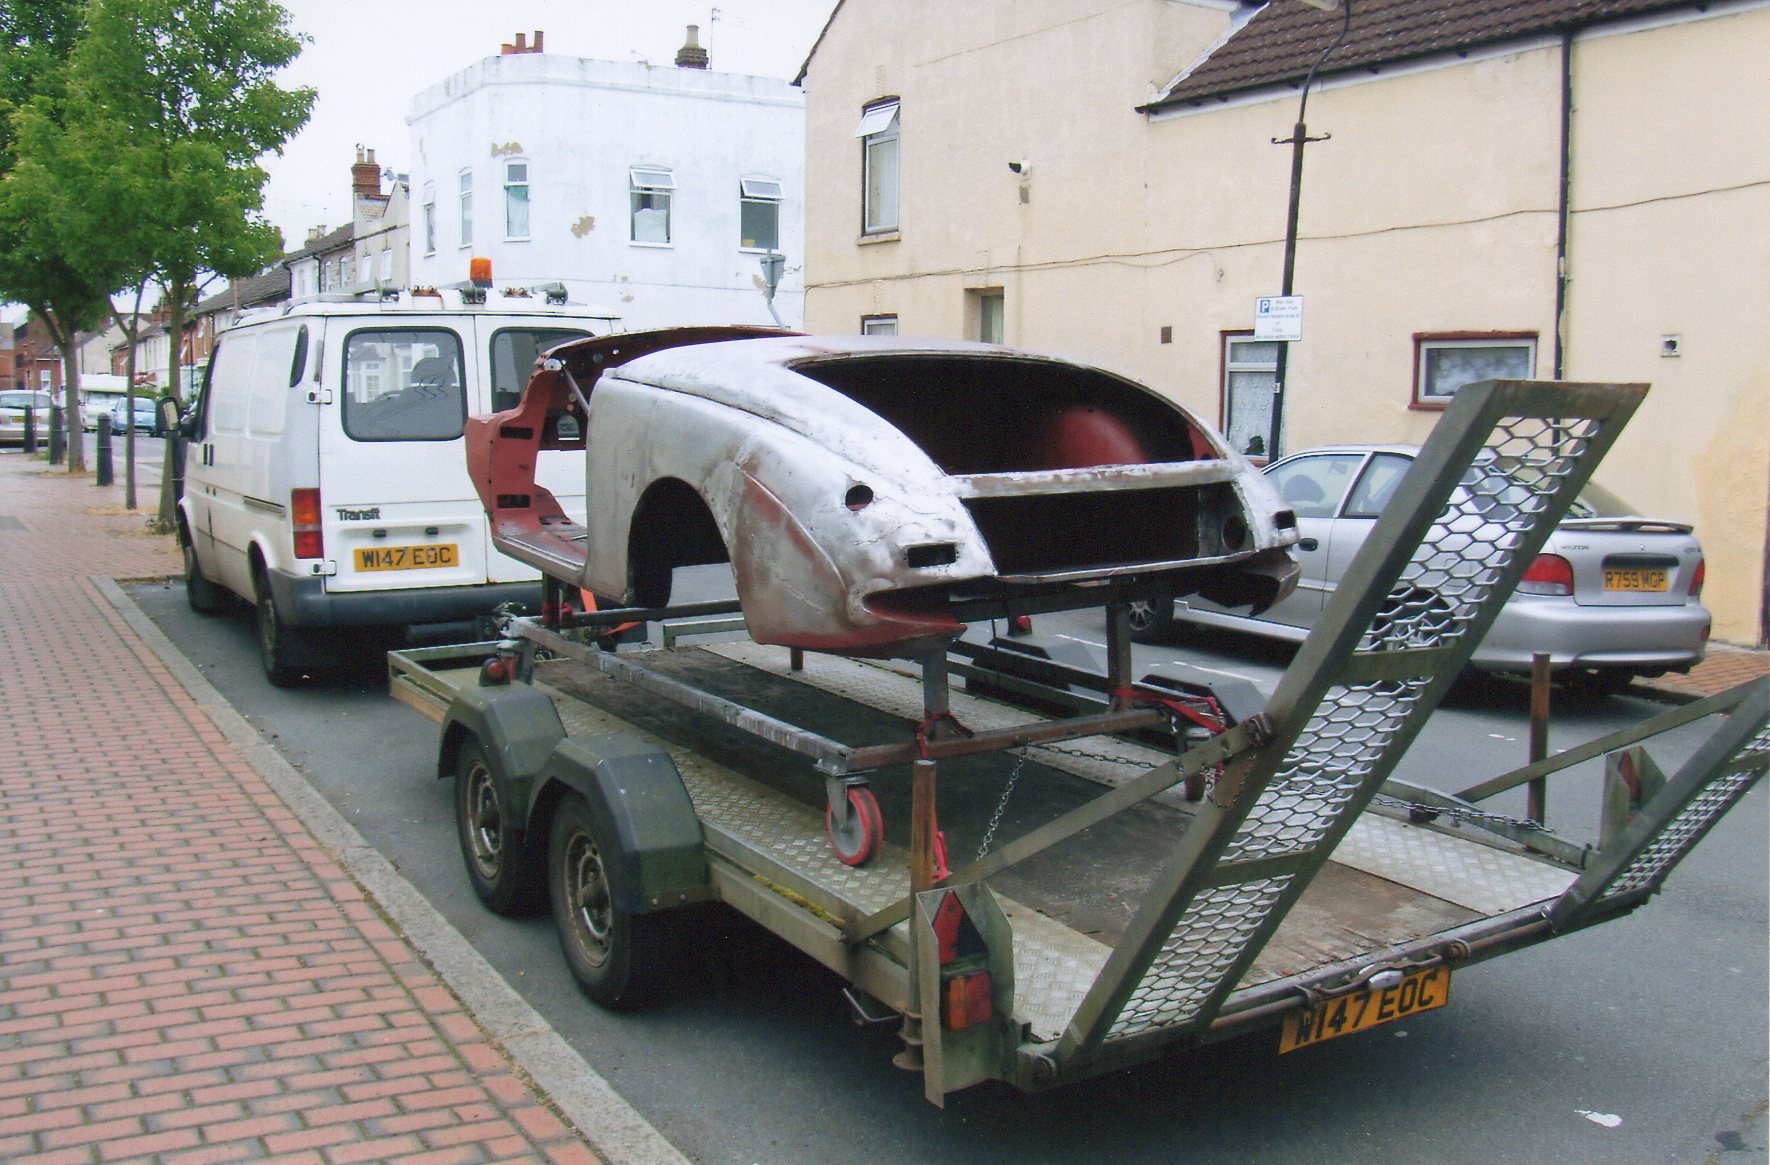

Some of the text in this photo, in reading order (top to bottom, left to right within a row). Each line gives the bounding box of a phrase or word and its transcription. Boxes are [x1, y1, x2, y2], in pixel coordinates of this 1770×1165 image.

[1261, 300, 1270, 313] P
[336, 508, 380, 521] Transit
[362, 549, 406, 568] W147
[1605, 571, 1638, 588] R759
[1377, 972, 1438, 1021] EOC
